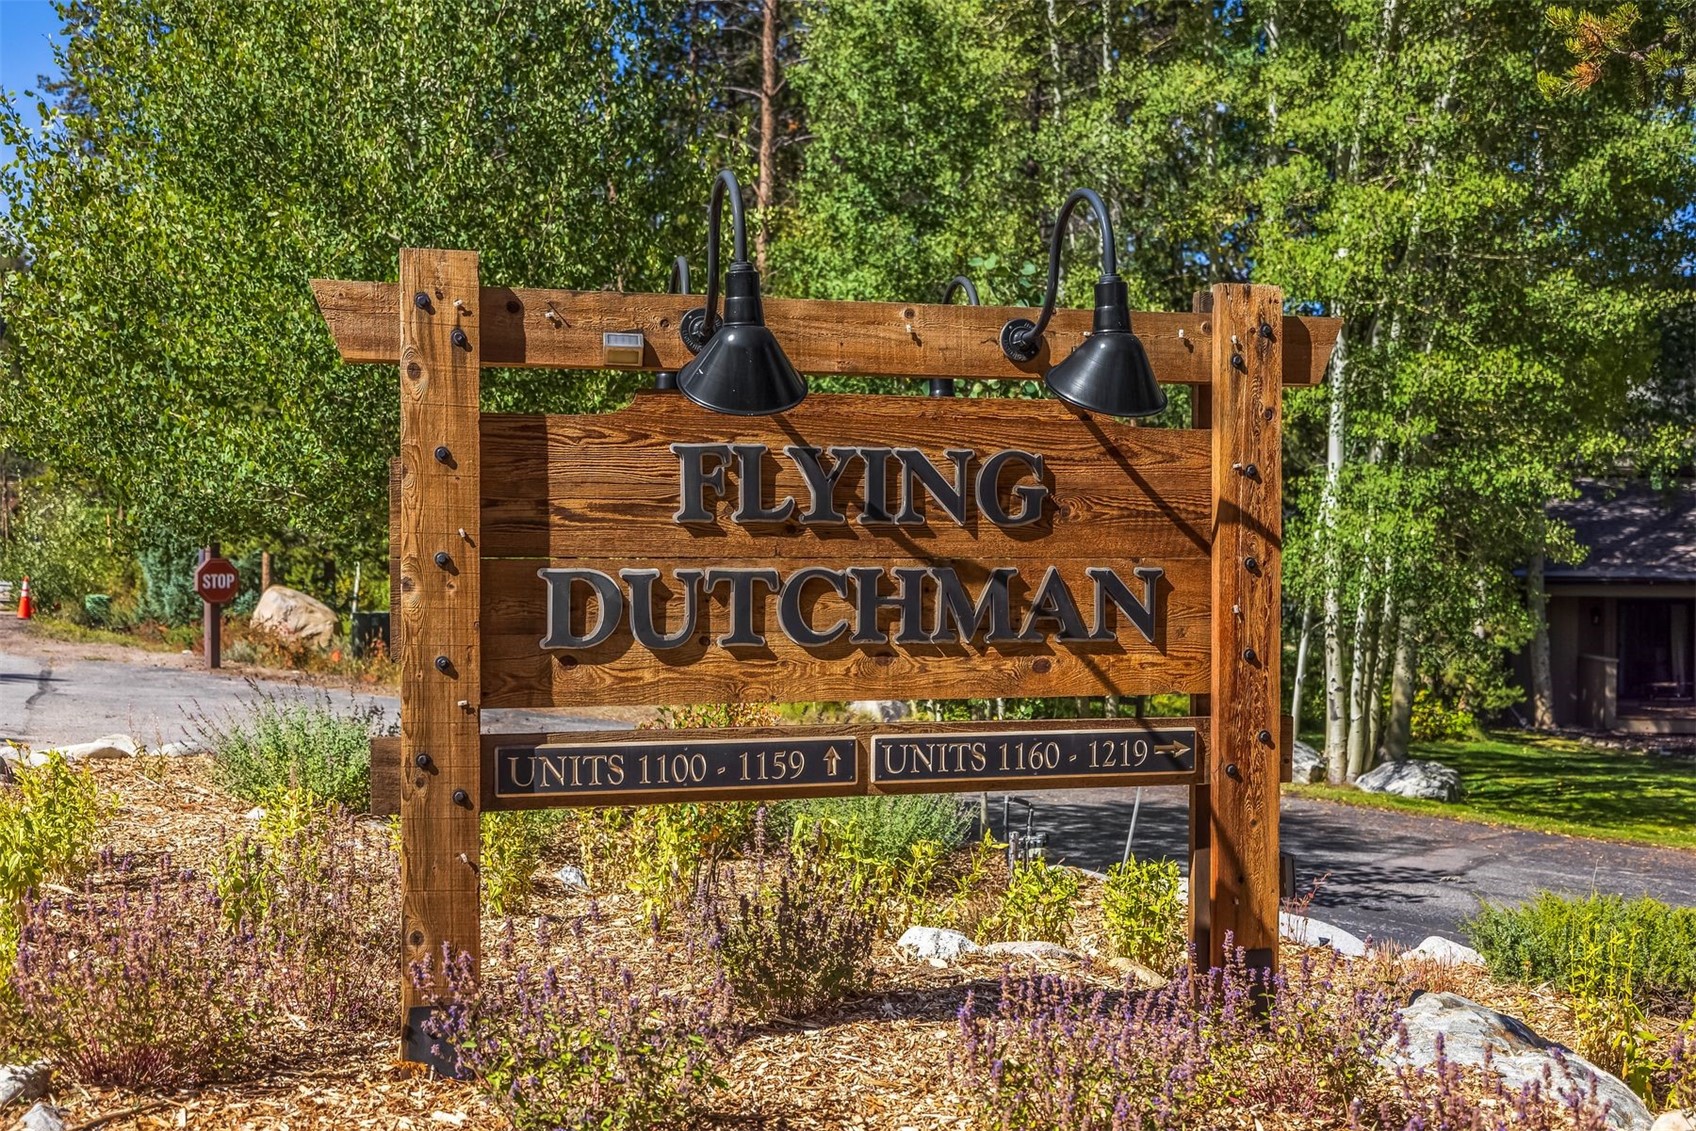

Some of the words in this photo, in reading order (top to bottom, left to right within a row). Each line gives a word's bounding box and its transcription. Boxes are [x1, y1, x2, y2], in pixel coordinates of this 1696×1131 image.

[670, 442, 1049, 527] FLYING
[202, 573, 235, 589] STOP
[537, 565, 1164, 650] DUTCHMAN
[507, 754, 625, 787] UNITS
[638, 753, 707, 784] 1100
[738, 750, 806, 781] 1159
[881, 742, 987, 774] UNITS
[998, 741, 1061, 772] 1160
[1088, 739, 1149, 769] 1219
